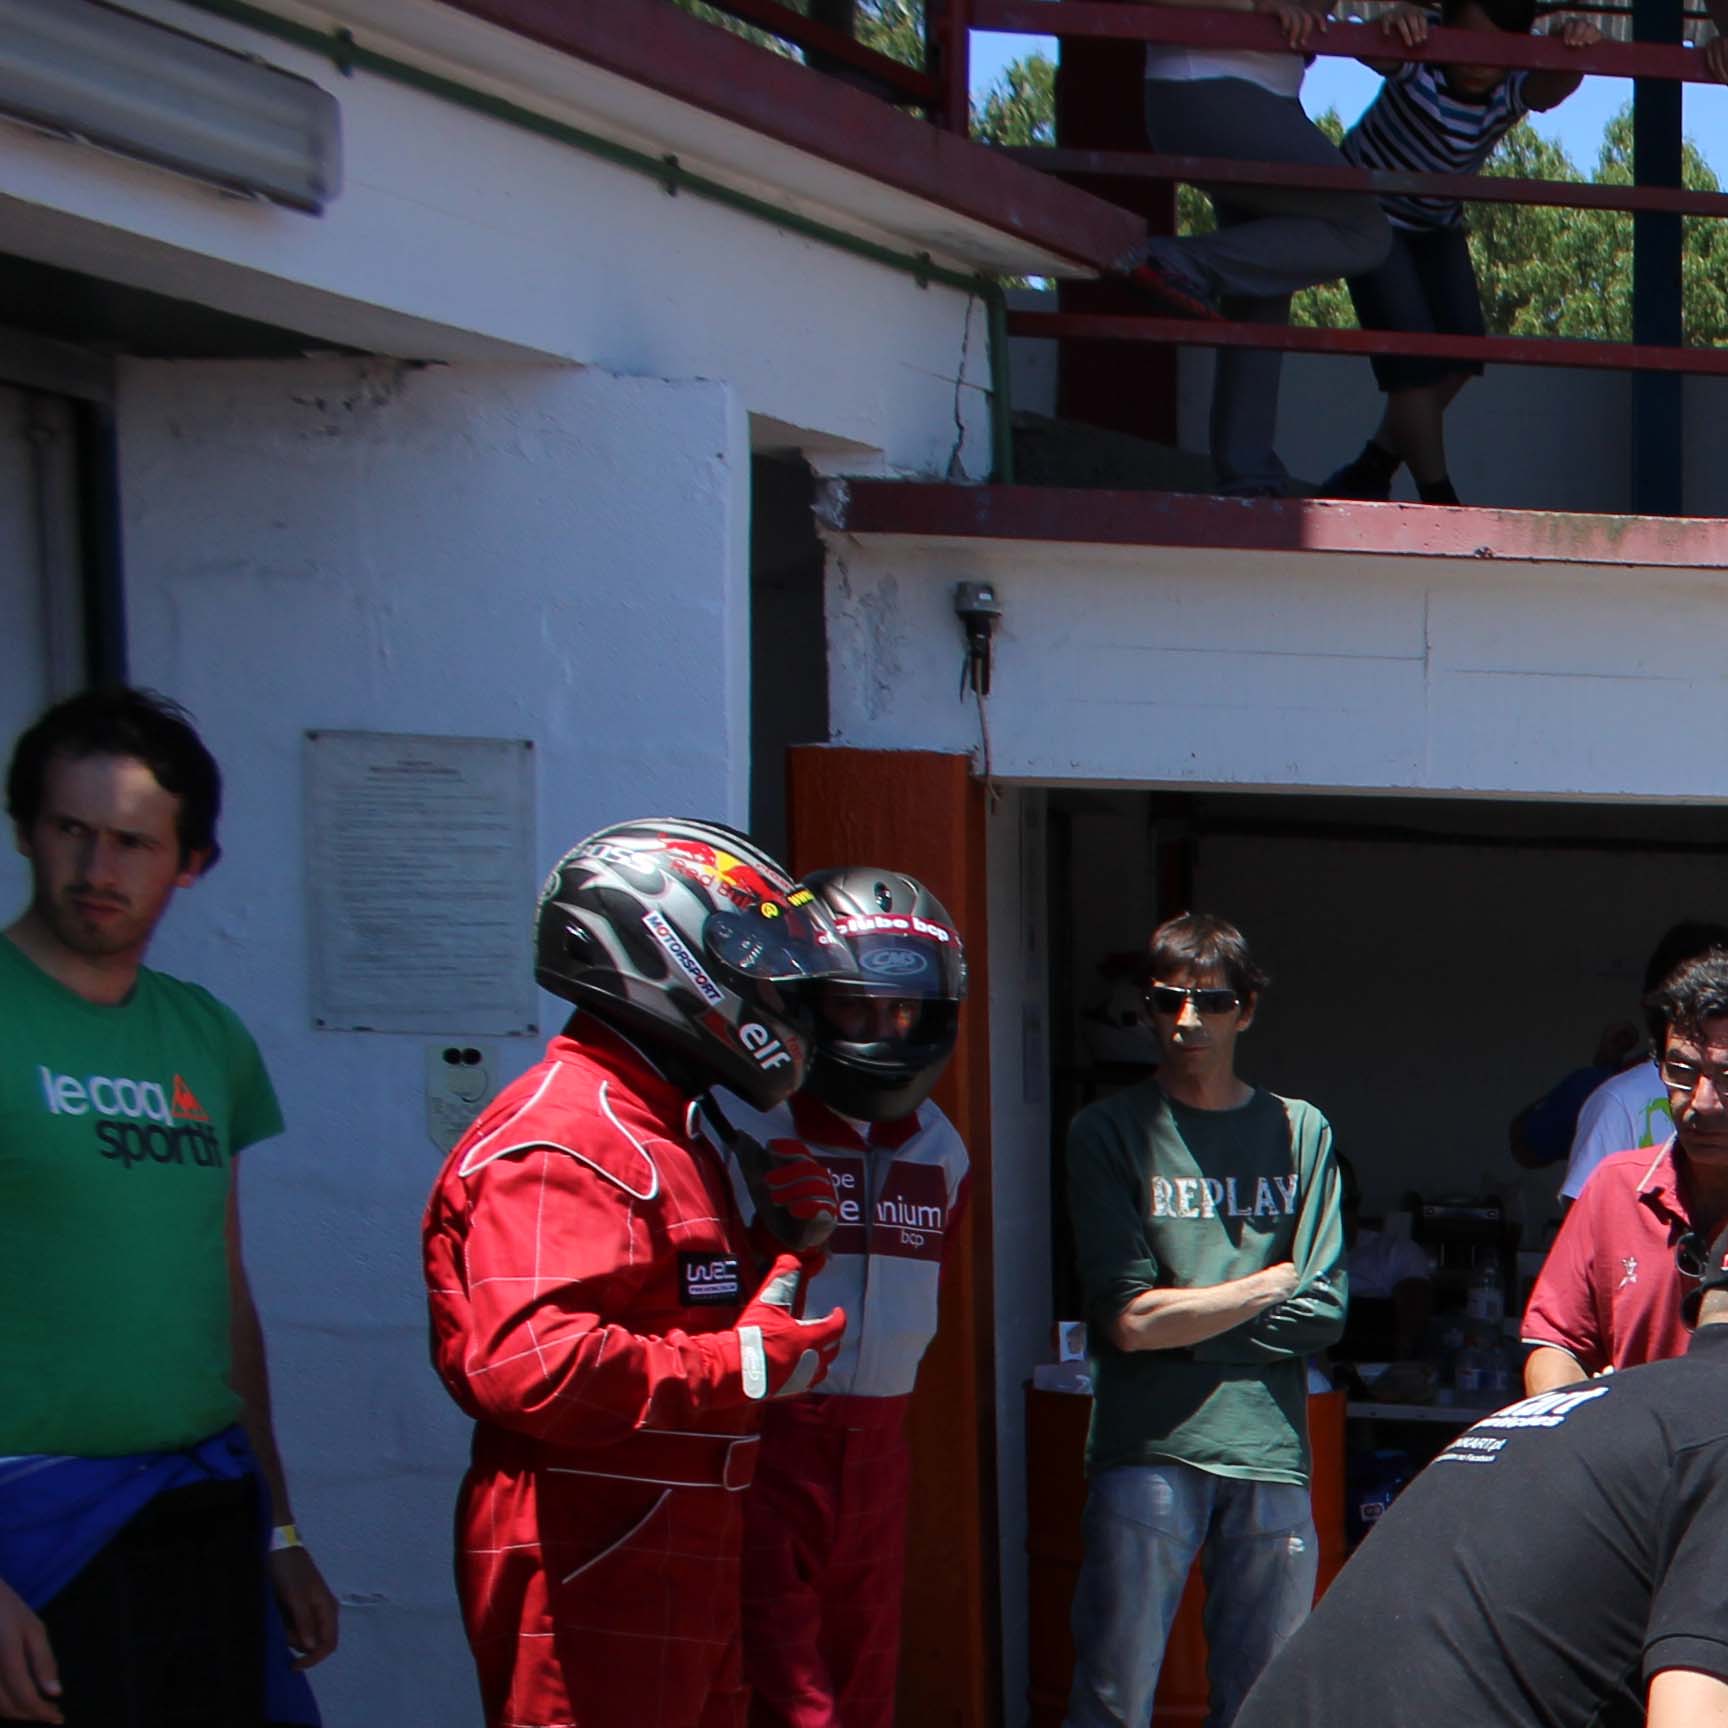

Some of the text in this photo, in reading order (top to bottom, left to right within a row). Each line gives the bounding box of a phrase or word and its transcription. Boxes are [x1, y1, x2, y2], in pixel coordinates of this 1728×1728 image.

[648, 915, 726, 1001] MOTORSPORT
[738, 1022, 793, 1071] elf
[1150, 1173, 1299, 1220] REPLAY
[901, 1230, 924, 1248] bcp
